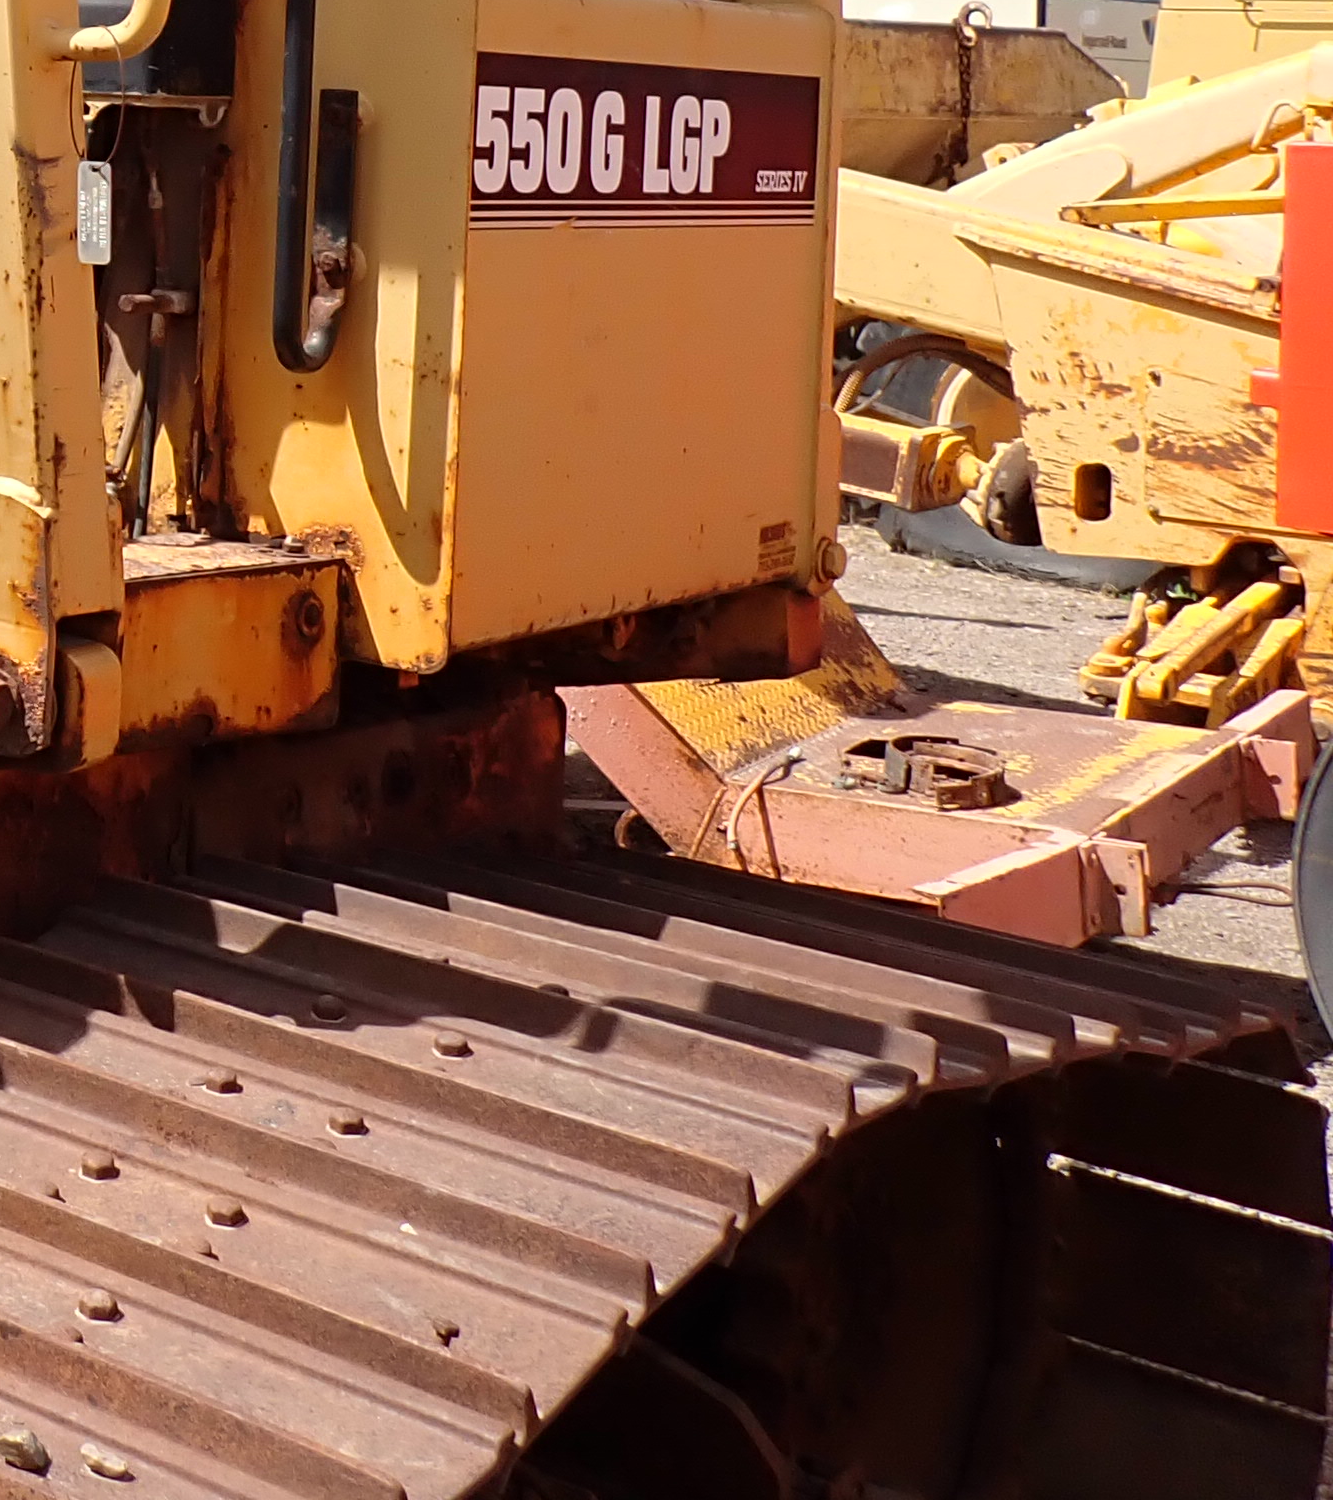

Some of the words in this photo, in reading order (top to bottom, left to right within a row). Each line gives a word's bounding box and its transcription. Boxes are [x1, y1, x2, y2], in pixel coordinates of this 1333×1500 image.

[641, 93, 732, 195] LGP
[754, 169, 792, 194] SERIES
[792, 170, 808, 193] IV
